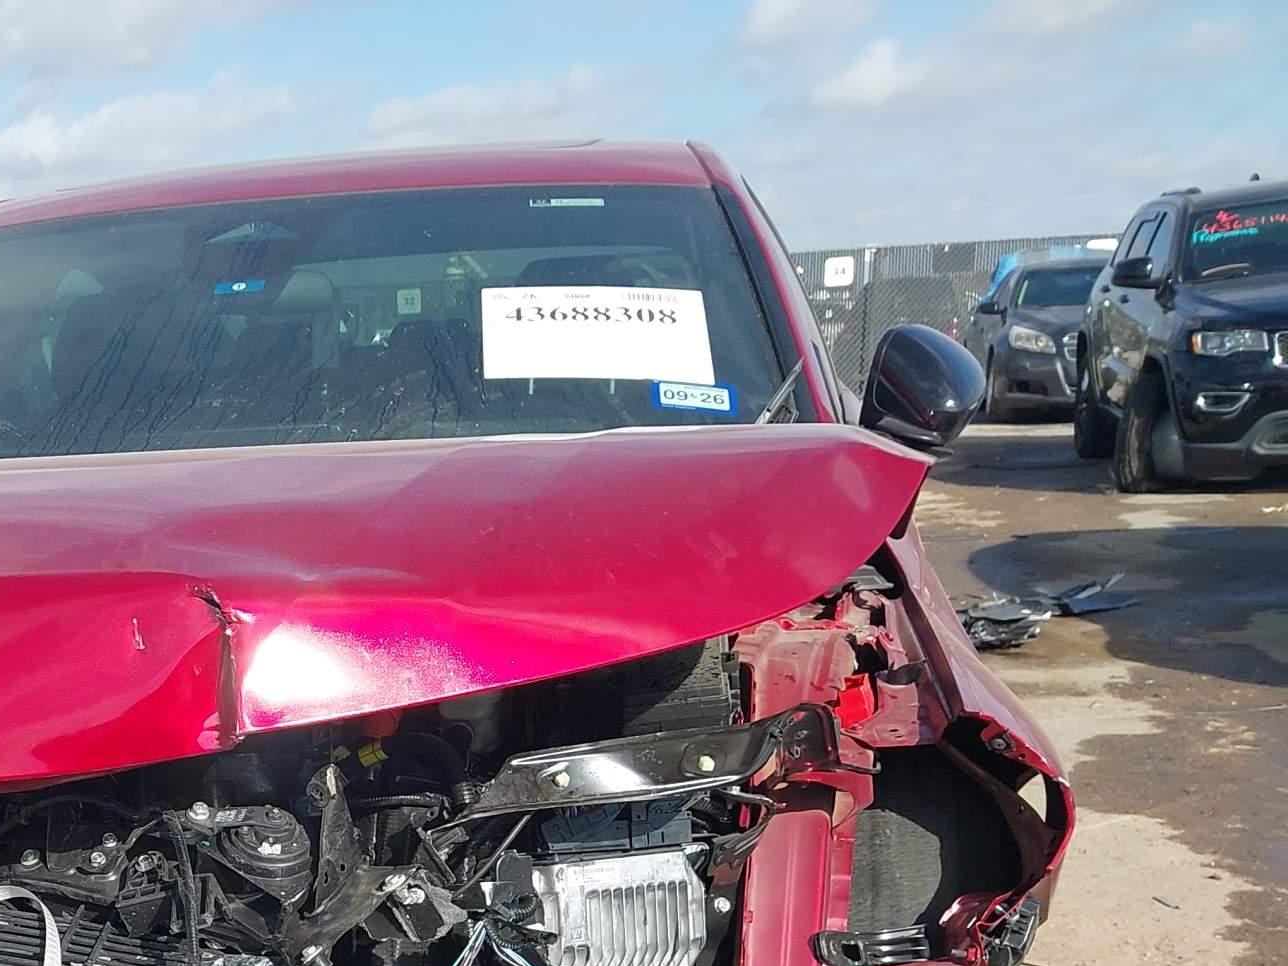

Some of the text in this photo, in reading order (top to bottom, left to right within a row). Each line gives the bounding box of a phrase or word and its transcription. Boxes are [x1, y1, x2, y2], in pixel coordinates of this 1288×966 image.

[505, 306, 677, 324] 43688308
[663, 389, 725, 405] 09 26
